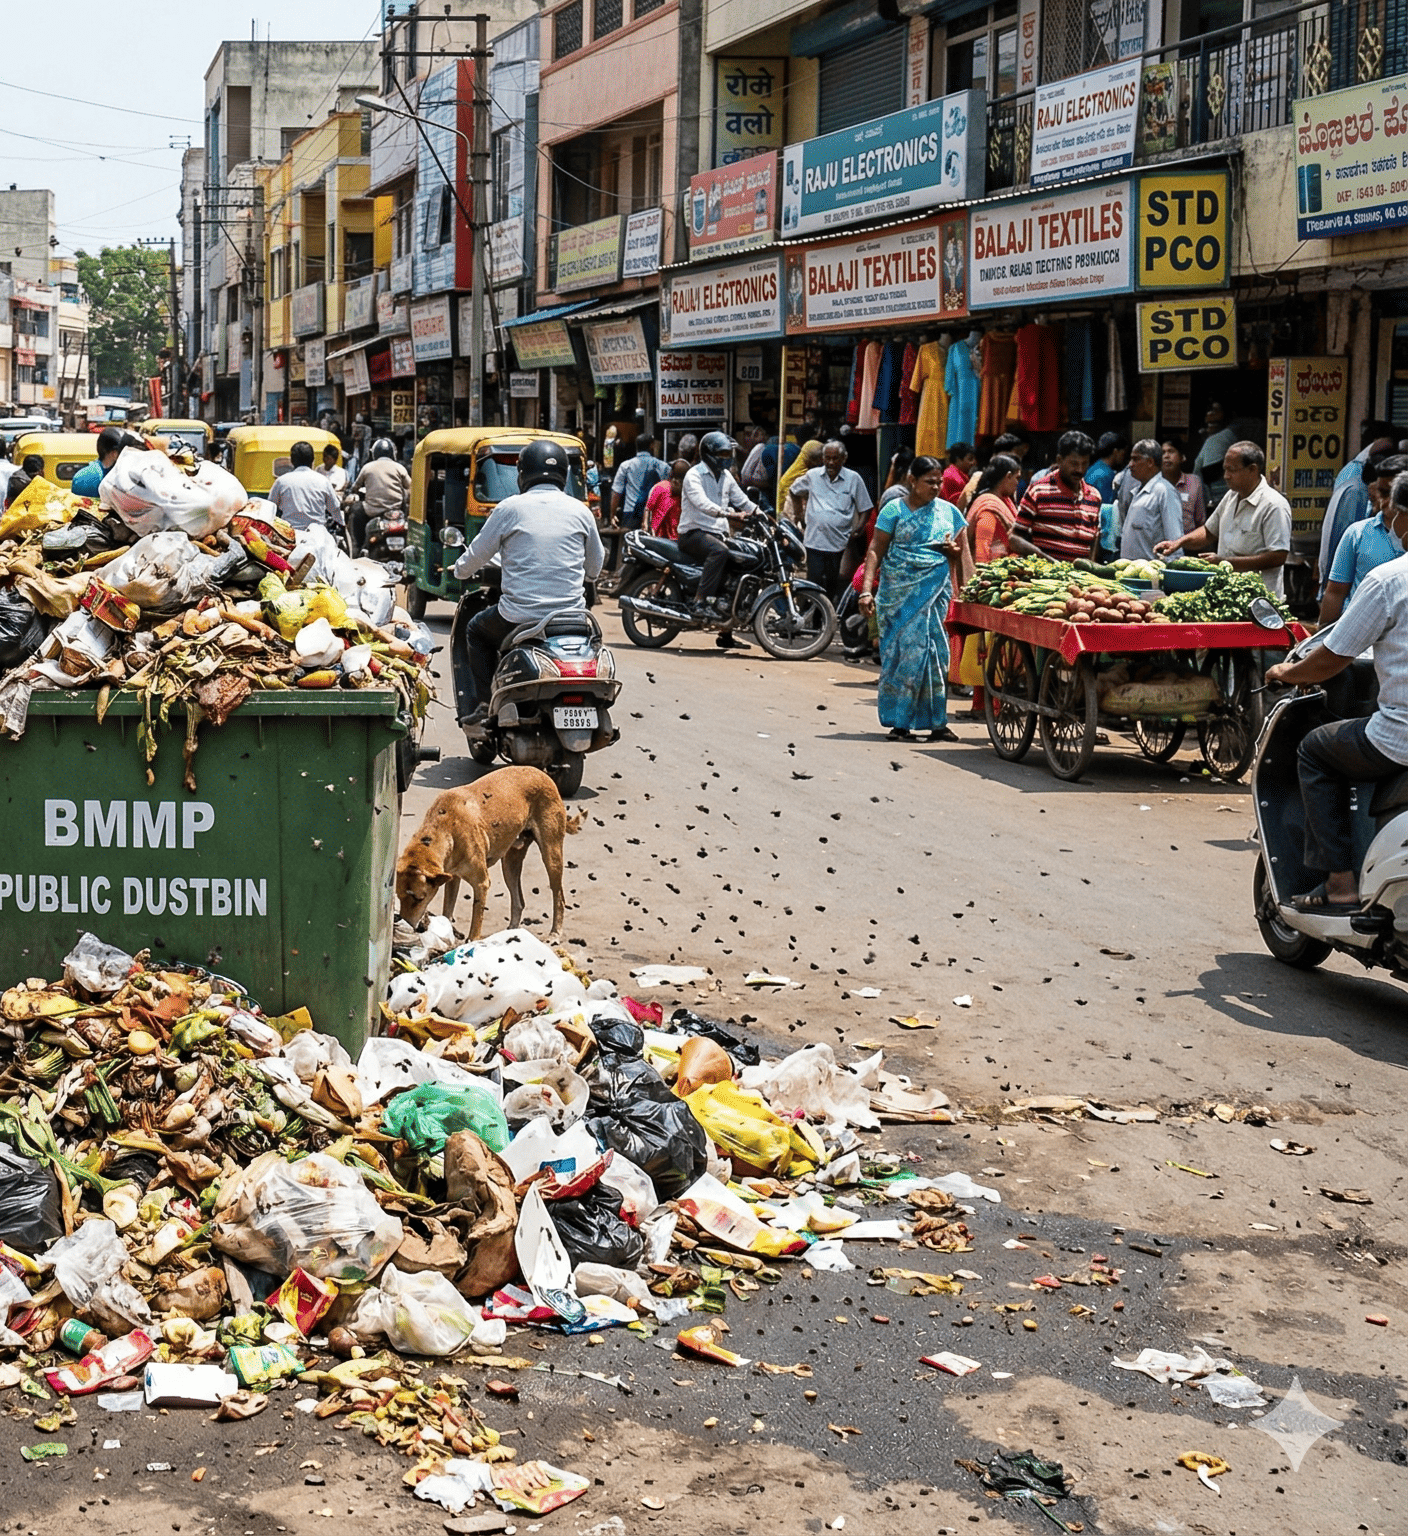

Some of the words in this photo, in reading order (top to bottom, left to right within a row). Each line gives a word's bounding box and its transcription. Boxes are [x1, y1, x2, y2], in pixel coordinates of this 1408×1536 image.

[1036, 102, 1064, 131] RAJU
[1065, 81, 1136, 124] ELECTRONICS
[805, 160, 838, 194] RAJU
[841, 131, 938, 184] ELECTRONICS
[1145, 189, 1220, 227] STD
[974, 217, 1033, 260] BALAJI
[1038, 200, 1123, 250] TEXTILES
[808, 259, 859, 296] BALAJI
[862, 245, 937, 289] TEXTILES
[1144, 235, 1221, 272] PCO
[703, 272, 777, 311] ELECTRONICS
[1150, 305, 1228, 334] STD
[1149, 335, 1230, 364] PCO
[1292, 433, 1341, 460] PCO
[44, 798, 215, 849] BMMP
[123, 877, 268, 917] DUSTBIN
